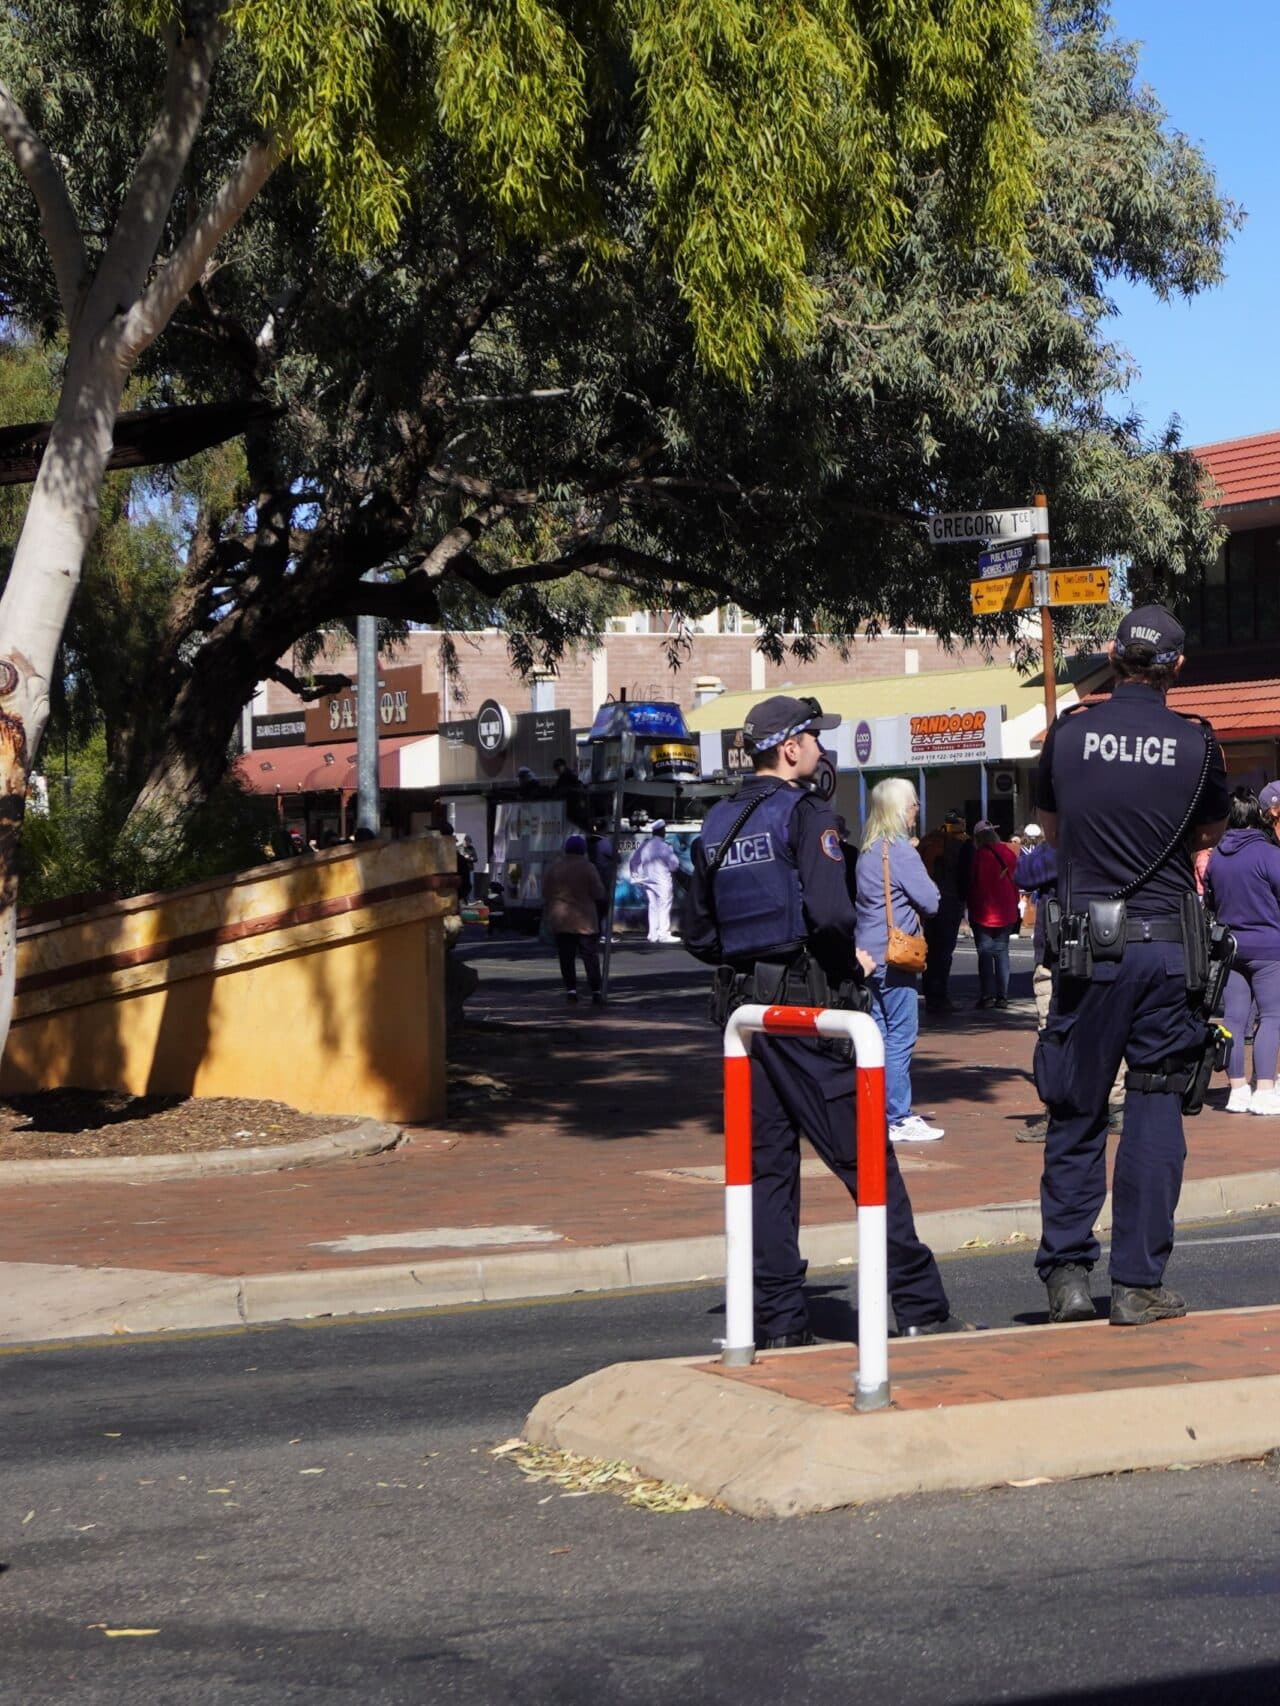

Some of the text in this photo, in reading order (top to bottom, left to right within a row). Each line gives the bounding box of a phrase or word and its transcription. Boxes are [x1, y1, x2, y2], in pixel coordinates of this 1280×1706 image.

[933, 513, 1003, 539] GREGORY
[990, 547, 1023, 564] PUBLIC TOILETS
[1130, 626, 1162, 645] POLICE
[329, 690, 408, 730] SAON
[910, 710, 986, 735] TANDOOR
[911, 729, 984, 745] EXPRESS
[1082, 732, 1177, 766] POLICE
